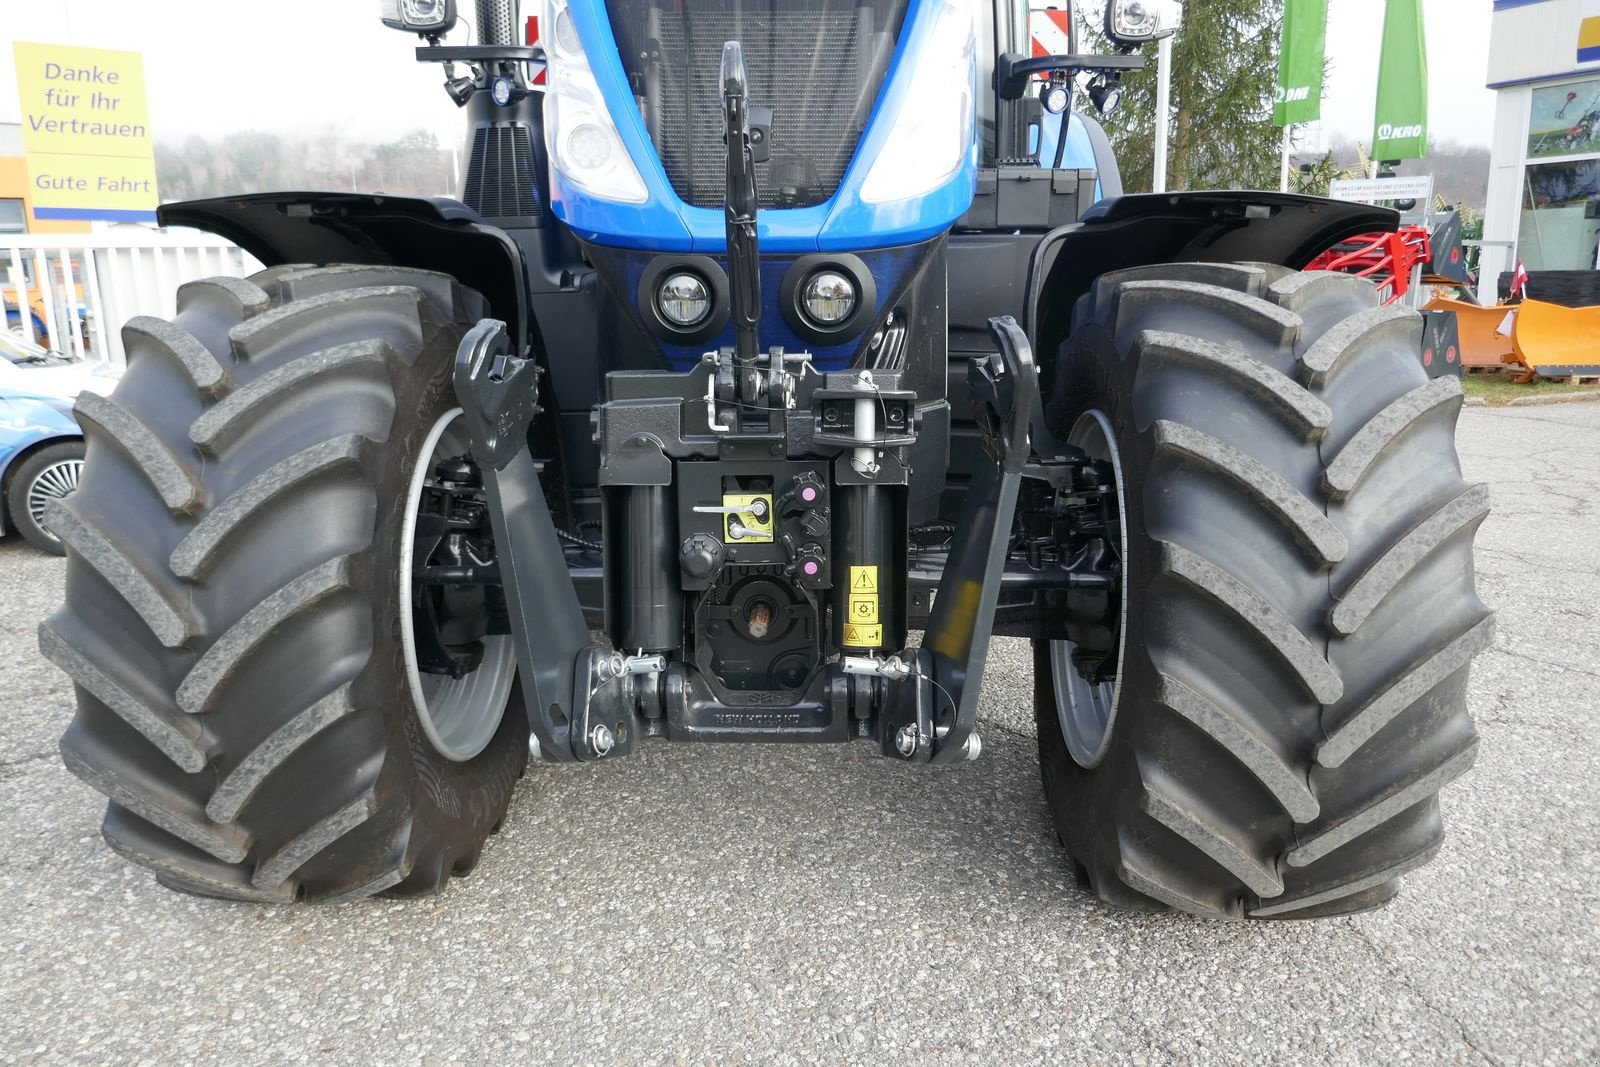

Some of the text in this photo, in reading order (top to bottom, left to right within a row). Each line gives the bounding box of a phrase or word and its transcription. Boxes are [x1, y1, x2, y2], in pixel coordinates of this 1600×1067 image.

[45, 63, 120, 85] Danke
[45, 88, 121, 110] für Ihr
[28, 114, 146, 138] Vertrauen
[35, 174, 151, 193] Gute Fahrt
